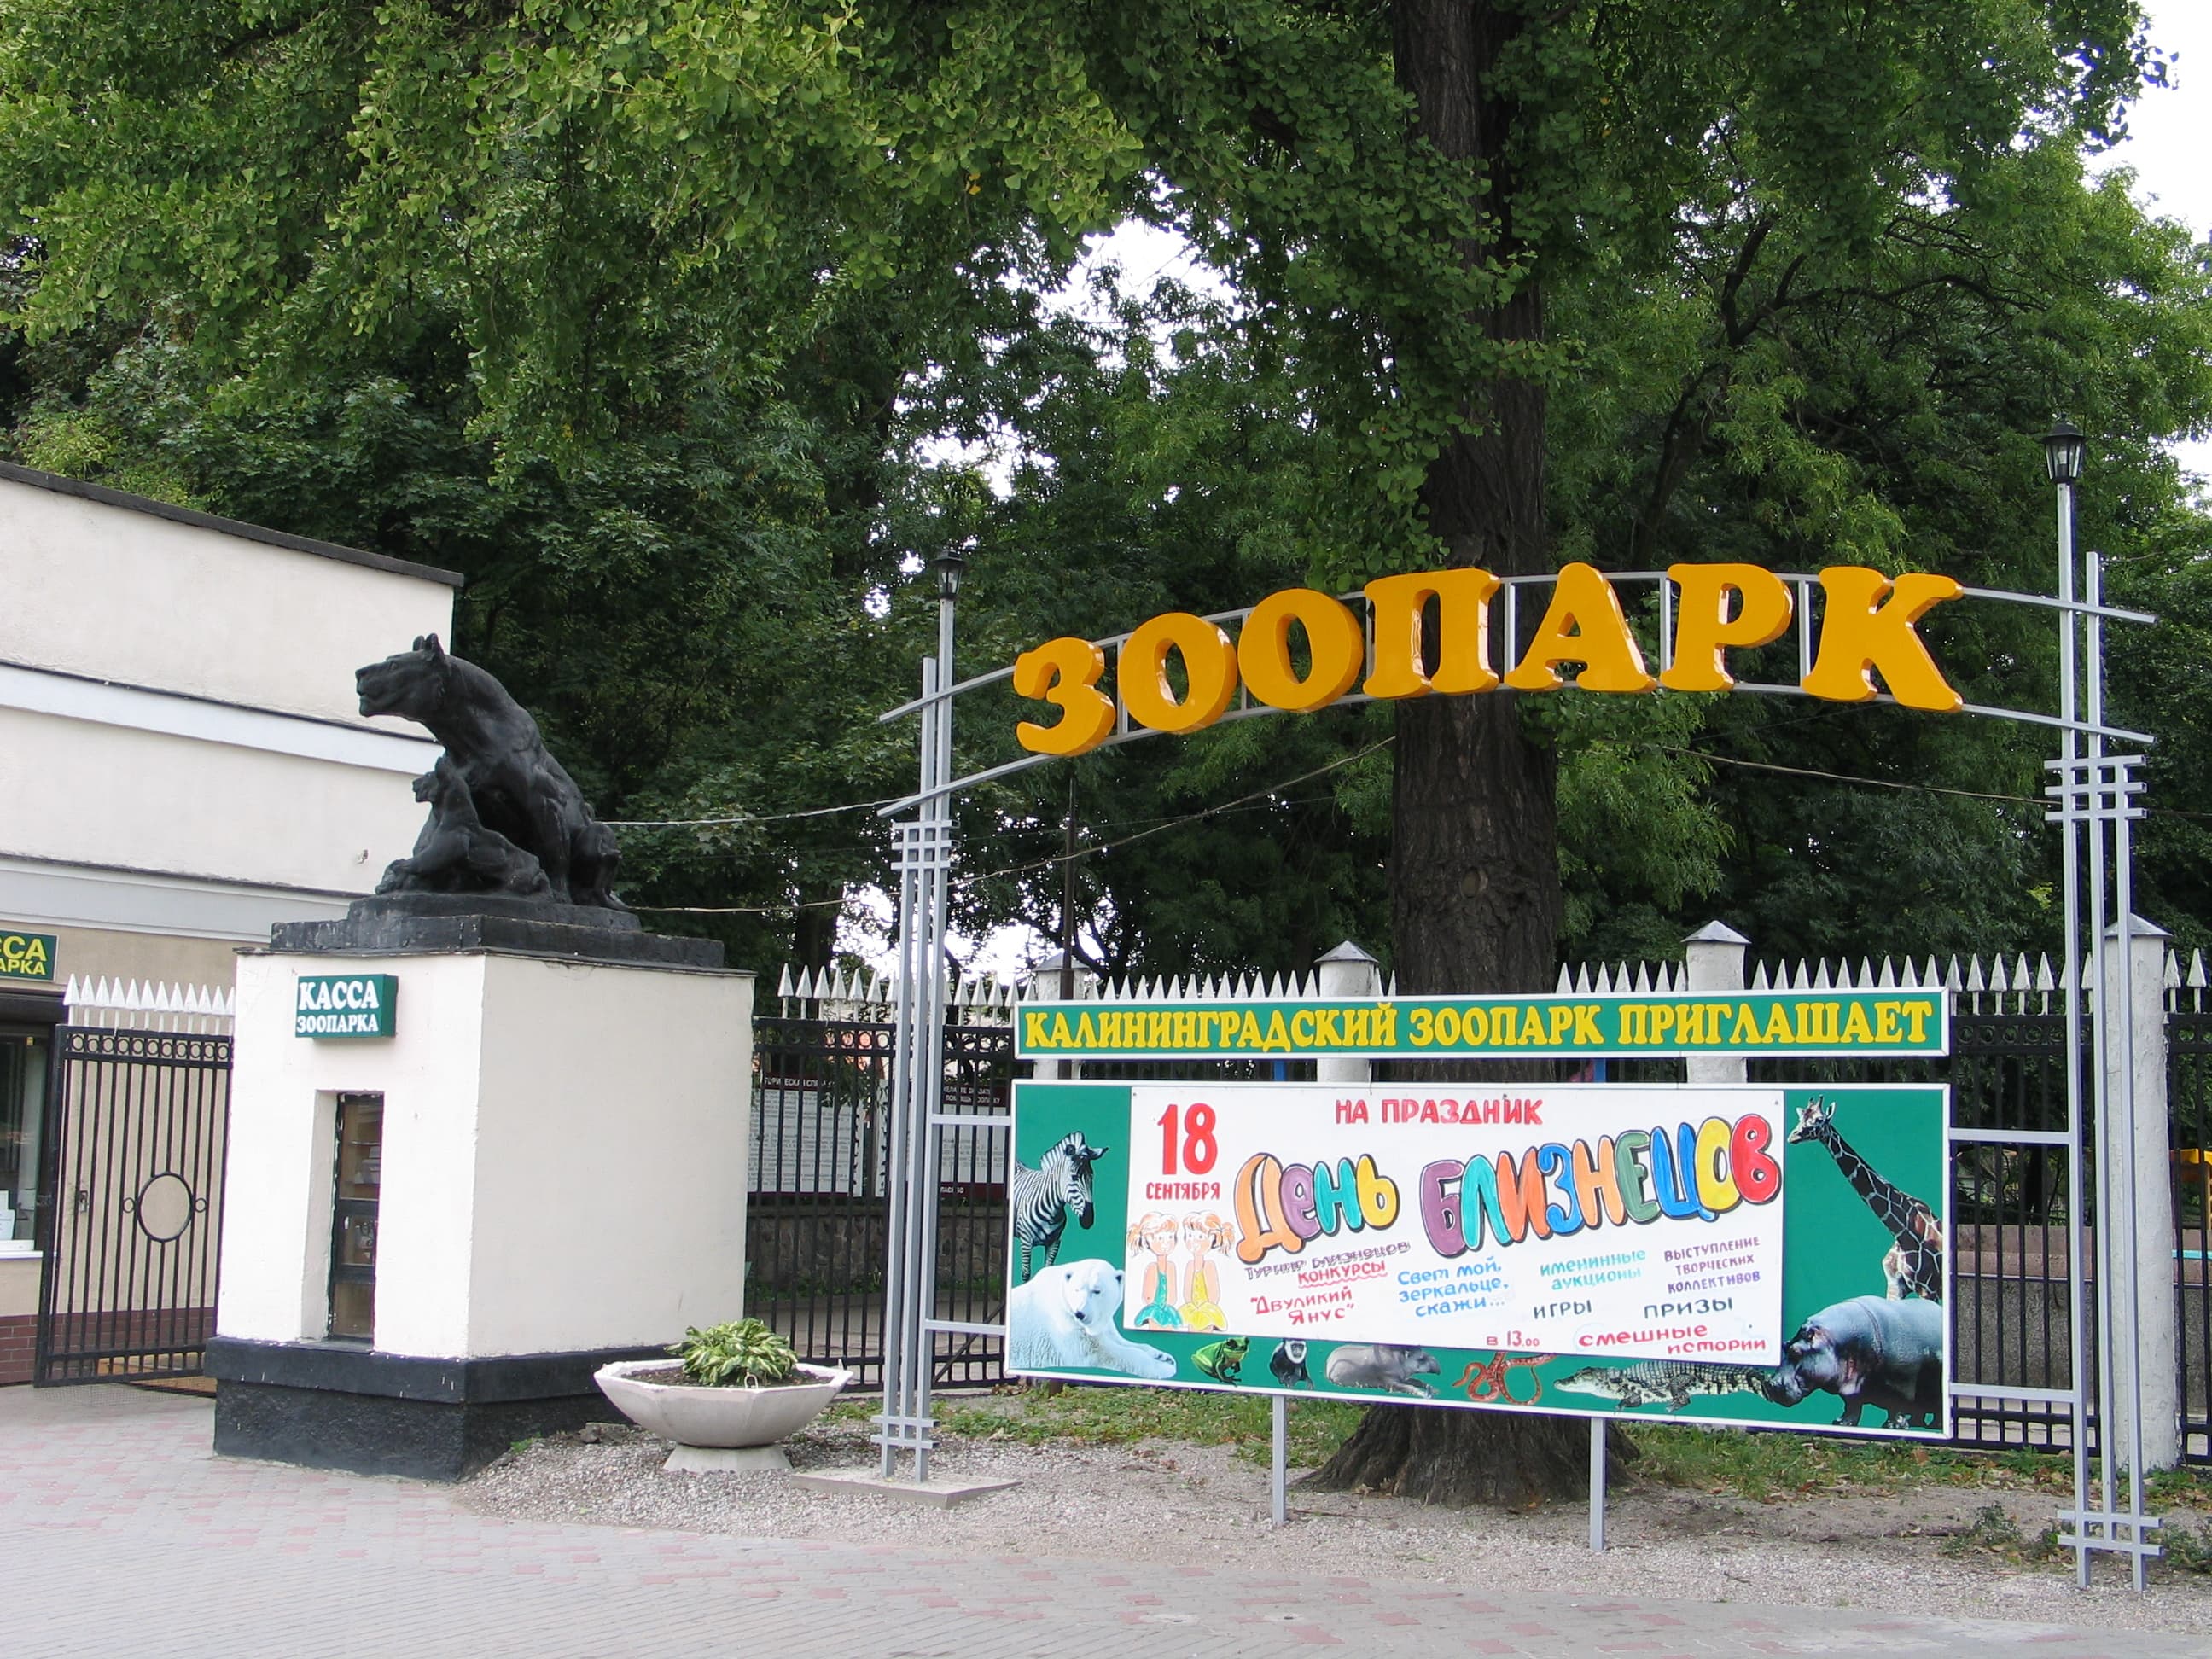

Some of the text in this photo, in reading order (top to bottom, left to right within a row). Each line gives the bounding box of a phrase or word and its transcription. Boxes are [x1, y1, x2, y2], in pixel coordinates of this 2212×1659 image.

[1012, 562, 1965, 758] ЗООПАРК
[298, 980, 380, 1011] КАССА
[296, 1015, 379, 1033] ЗООПАРКА
[1024, 1000, 1933, 1052] КАЛИНИНГРАДСКИЙ ЗООПАРК ПРИГЛАШАЕТ
[1336, 1098, 1543, 1125] НА ПРАЗДНИК
[1158, 1103, 1218, 1175] 18
[1146, 1182, 1221, 1200] СЕНТЯБРЯ
[1418, 1113, 1783, 1259] БЛИЗНЕЦОВ
[1664, 1236, 1761, 1263] ВЫСТУПЛЕНИЕ
[1297, 1260, 1387, 1285] КОНКУРСЫ
[1674, 1254, 1755, 1278] ТВОРЧЕСКИХ
[1667, 1270, 1761, 1295] КОЛЛЕКТИВОВ
[1533, 1299, 1592, 1320] ИГРЫ
[1644, 1297, 1733, 1320] ПРИЗЫ
